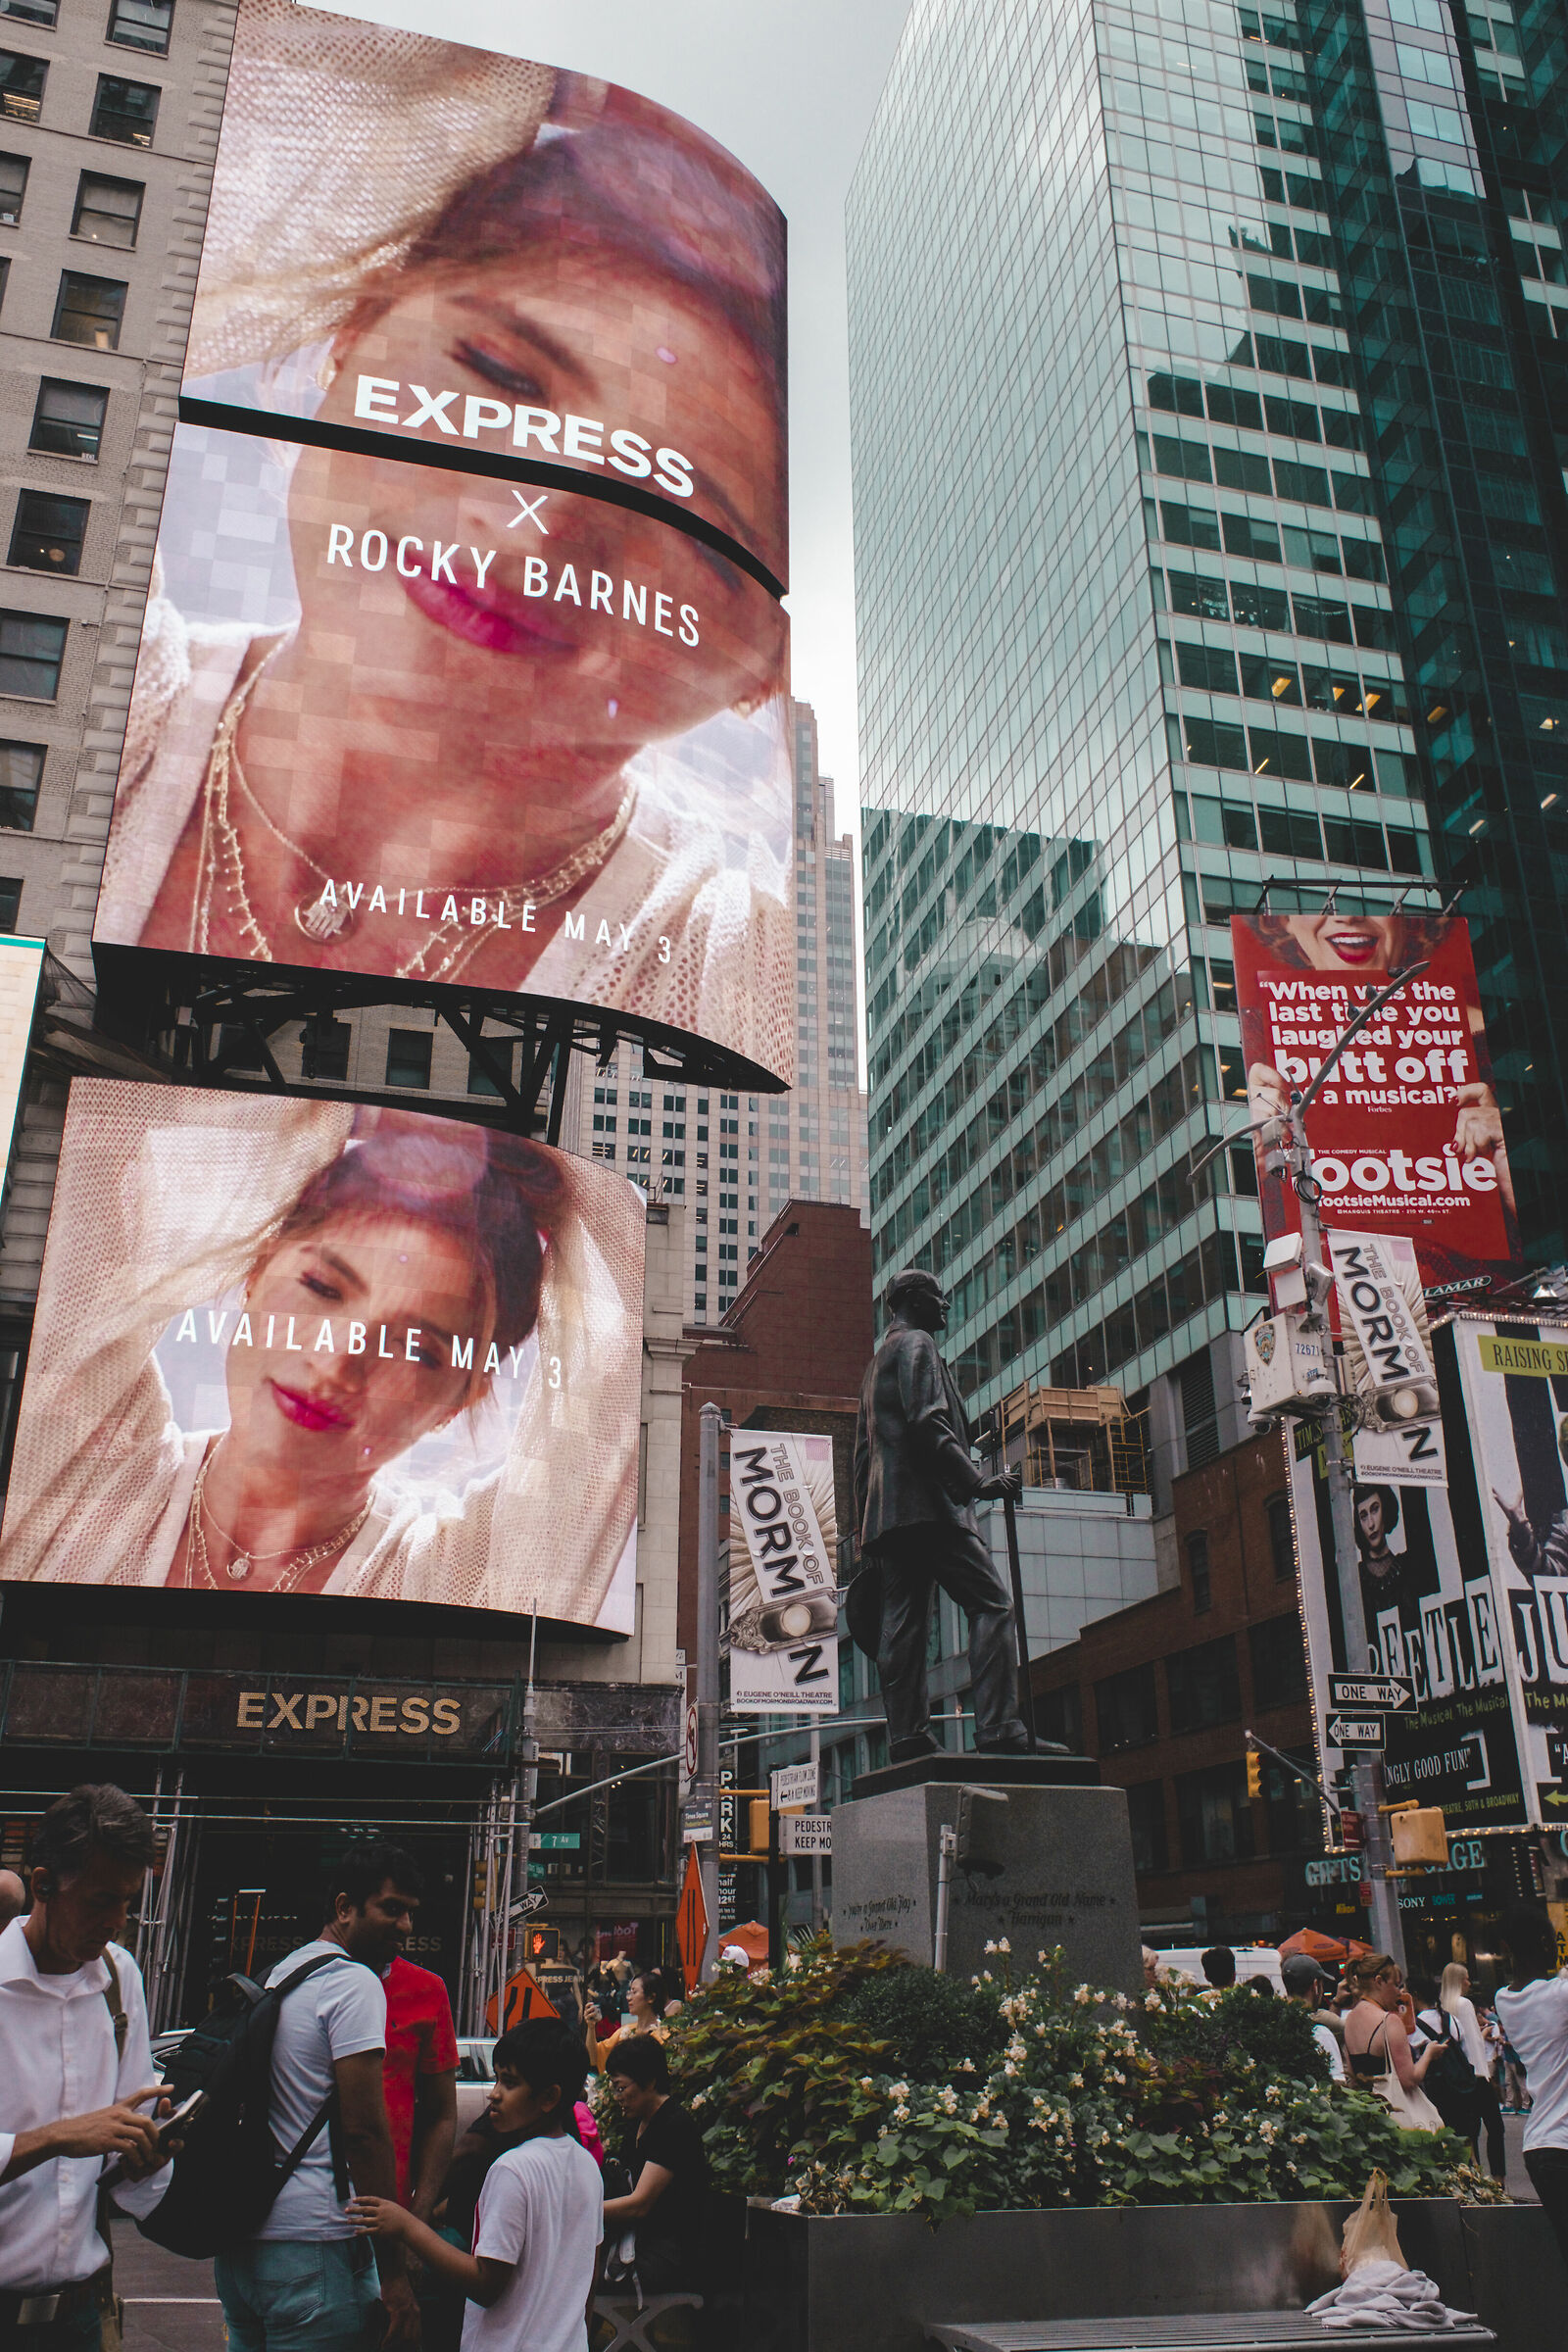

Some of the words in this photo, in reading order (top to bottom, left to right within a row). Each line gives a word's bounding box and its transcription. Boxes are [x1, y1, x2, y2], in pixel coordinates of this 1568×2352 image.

[354, 374, 694, 498] EXPRESS
[326, 523, 497, 589] ROCKY
[523, 556, 700, 647] BARNES
[319, 879, 536, 932] AVAILABLE
[564, 910, 633, 951] MAY
[658, 936, 671, 964] 3
[1411, 981, 1456, 1001] the
[1268, 1002, 1323, 1022] last
[1405, 1005, 1460, 1026] you
[1396, 1029, 1463, 1050] your
[1274, 1049, 1388, 1083] butt
[1395, 1049, 1469, 1083] off
[1323, 1090, 1339, 1104] a
[1425, 1276, 1485, 1297] LAMAR
[1363, 1244, 1388, 1280] THE
[1380, 1286, 1412, 1347] BOOK
[1403, 1345, 1426, 1373] OF
[175, 1308, 421, 1362] AVAILABLE
[451, 1335, 524, 1379] MAY
[548, 1356, 562, 1390] 3
[1296, 1343, 1319, 1357] 72671
[1493, 1344, 1552, 1371] RAISING
[770, 1443, 796, 1482] THE
[782, 1488, 814, 1550] BOOK
[803, 1551, 824, 1586] OF
[1342, 1686, 1367, 1699] ONE
[1377, 1687, 1403, 1701] WAY
[1524, 1692, 1549, 1709] The
[236, 1691, 462, 1736] EXPRESS
[1404, 1716, 1419, 1731] The
[1456, 1702, 1474, 1717] The
[1334, 1725, 1349, 1738] ONE
[1357, 1725, 1377, 1738] WAY
[1414, 1759, 1442, 1780] GOOD
[1487, 1792, 1519, 1809] BROADWAY
[552, 1836, 558, 1847] 7
[795, 1836, 816, 1848] KEEP
[1304, 1856, 1362, 1886] GIFTS
[519, 1893, 538, 1910] WAY
[1336, 1903, 1356, 1914] Nikon
[1397, 1896, 1426, 1910] SONY
